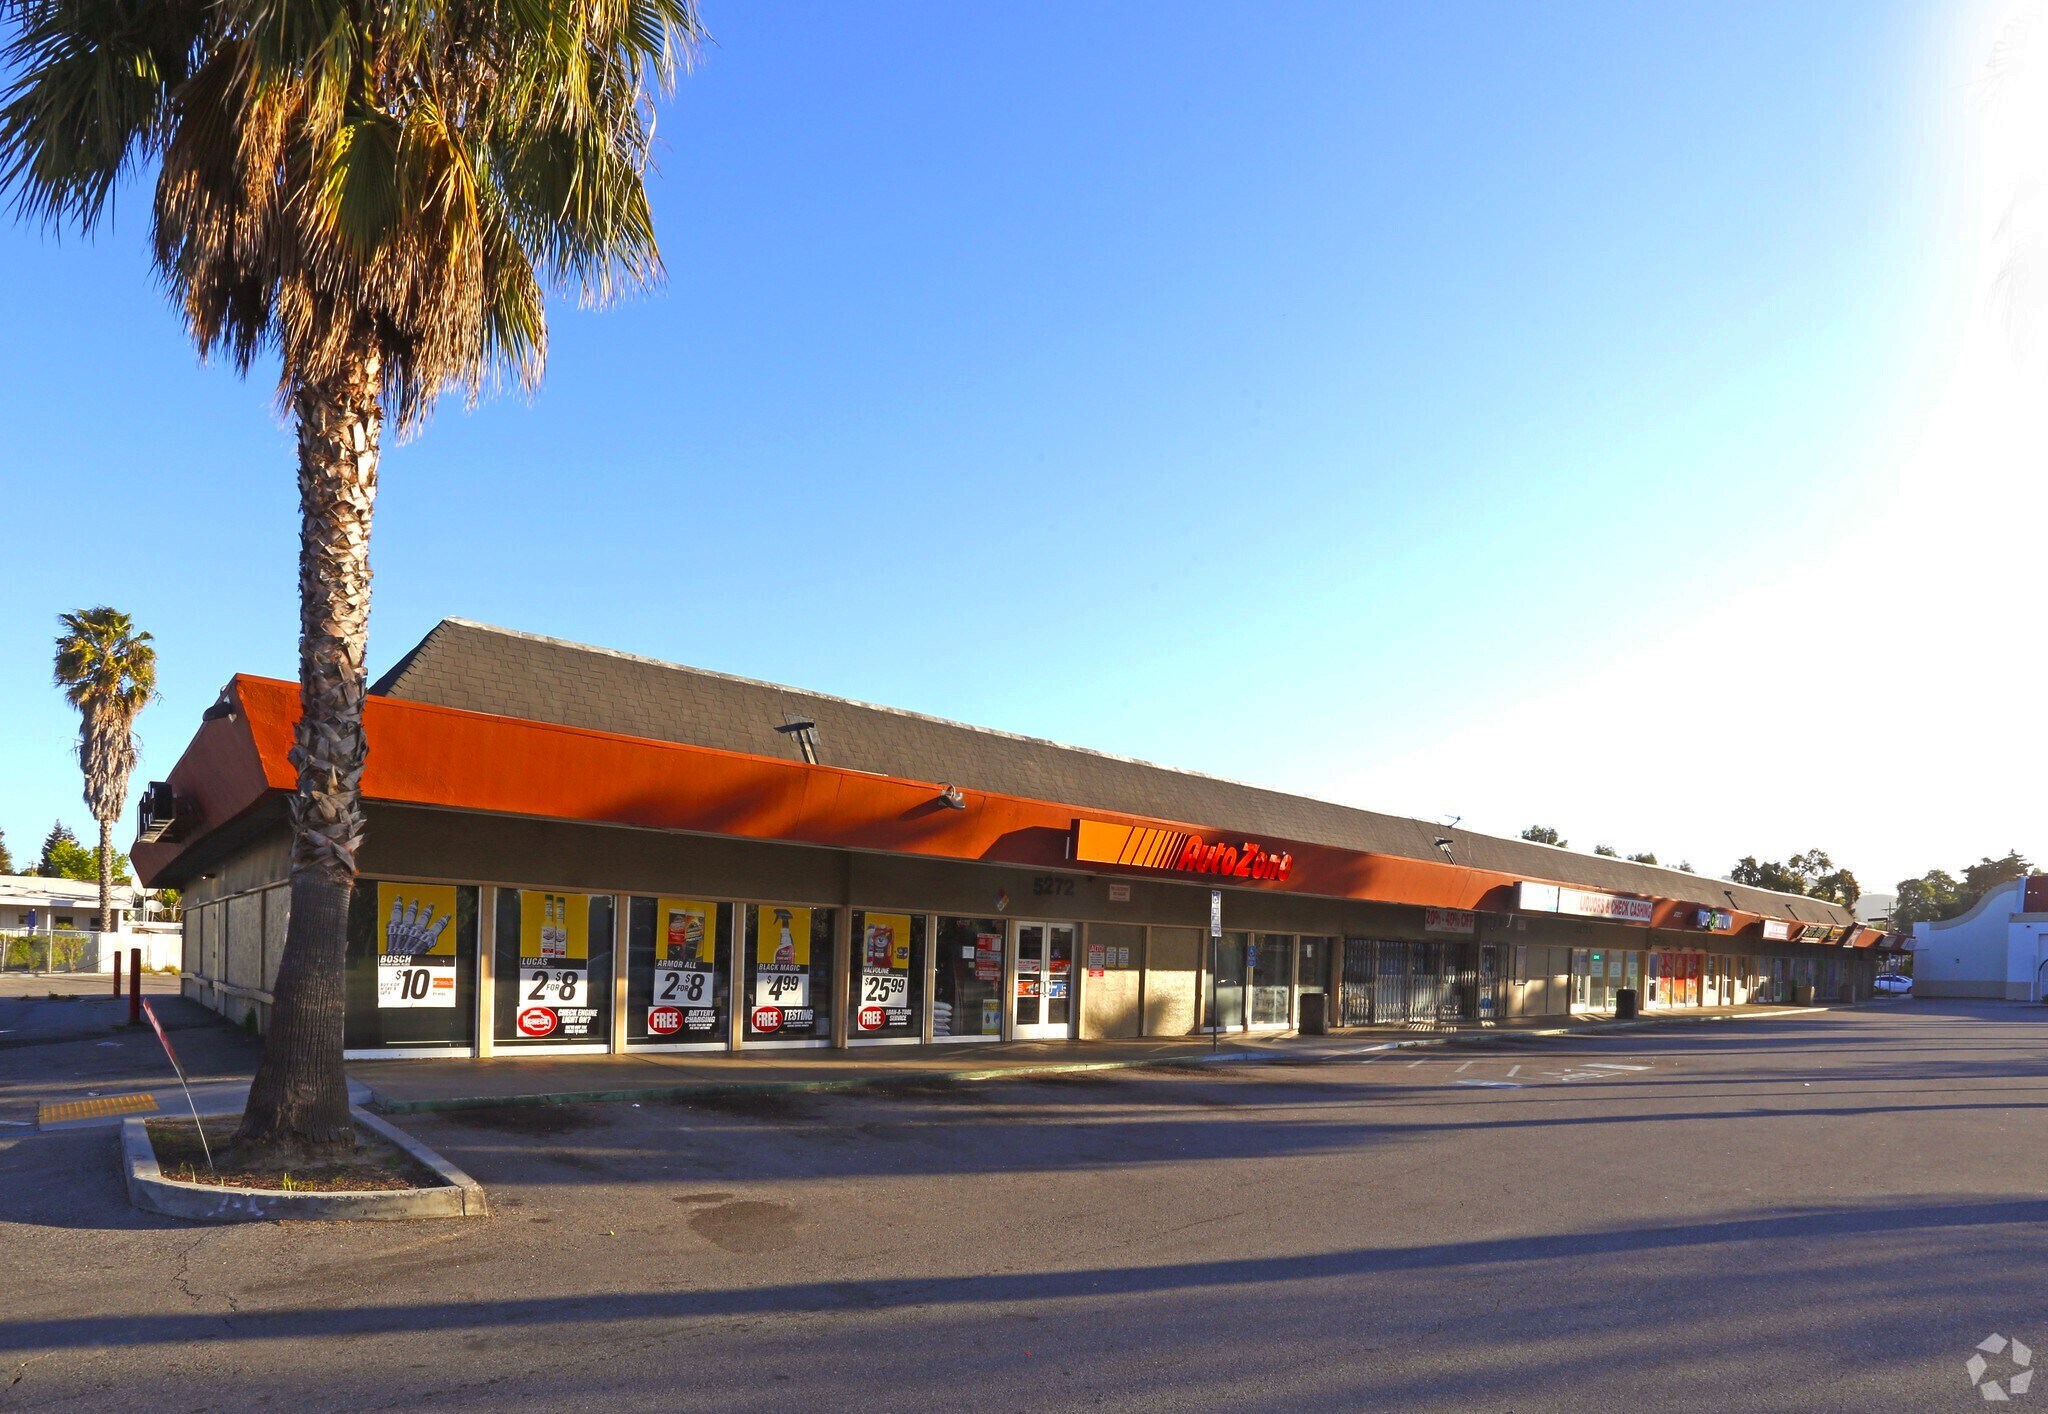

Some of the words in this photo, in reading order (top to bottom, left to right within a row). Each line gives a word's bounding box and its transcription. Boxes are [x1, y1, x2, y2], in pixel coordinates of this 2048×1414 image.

[1177, 833, 1293, 882] AutoZone
[1611, 897, 1629, 917] CHECK
[1629, 899, 1652, 919] CASHING
[1461, 912, 1474, 928] OFF
[380, 954, 412, 963] BOSCH
[521, 957, 548, 966] LUCAS
[657, 959, 684, 969] ARMOR
[758, 963, 779, 971] BLACK
[780, 964, 801, 972] MAGIC
[395, 968, 431, 1000] $10
[527, 970, 550, 1001] 2
[545, 983, 560, 991] FOR
[555, 970, 579, 1001] $8
[660, 971, 680, 1000] 2
[676, 984, 690, 992] FOR
[684, 973, 706, 1002] $8
[557, 1008, 578, 1017] CHECK
[577, 1009, 598, 1017] ENGINE
[688, 1009, 715, 1017] BATTERY
[756, 1011, 778, 1027] FREE
[784, 1009, 814, 1021] TESTING
[862, 1010, 882, 1026] FREE
[561, 1016, 578, 1024] LIGHT
[653, 1012, 678, 1029] FREE
[684, 1016, 716, 1024] CHARGING
